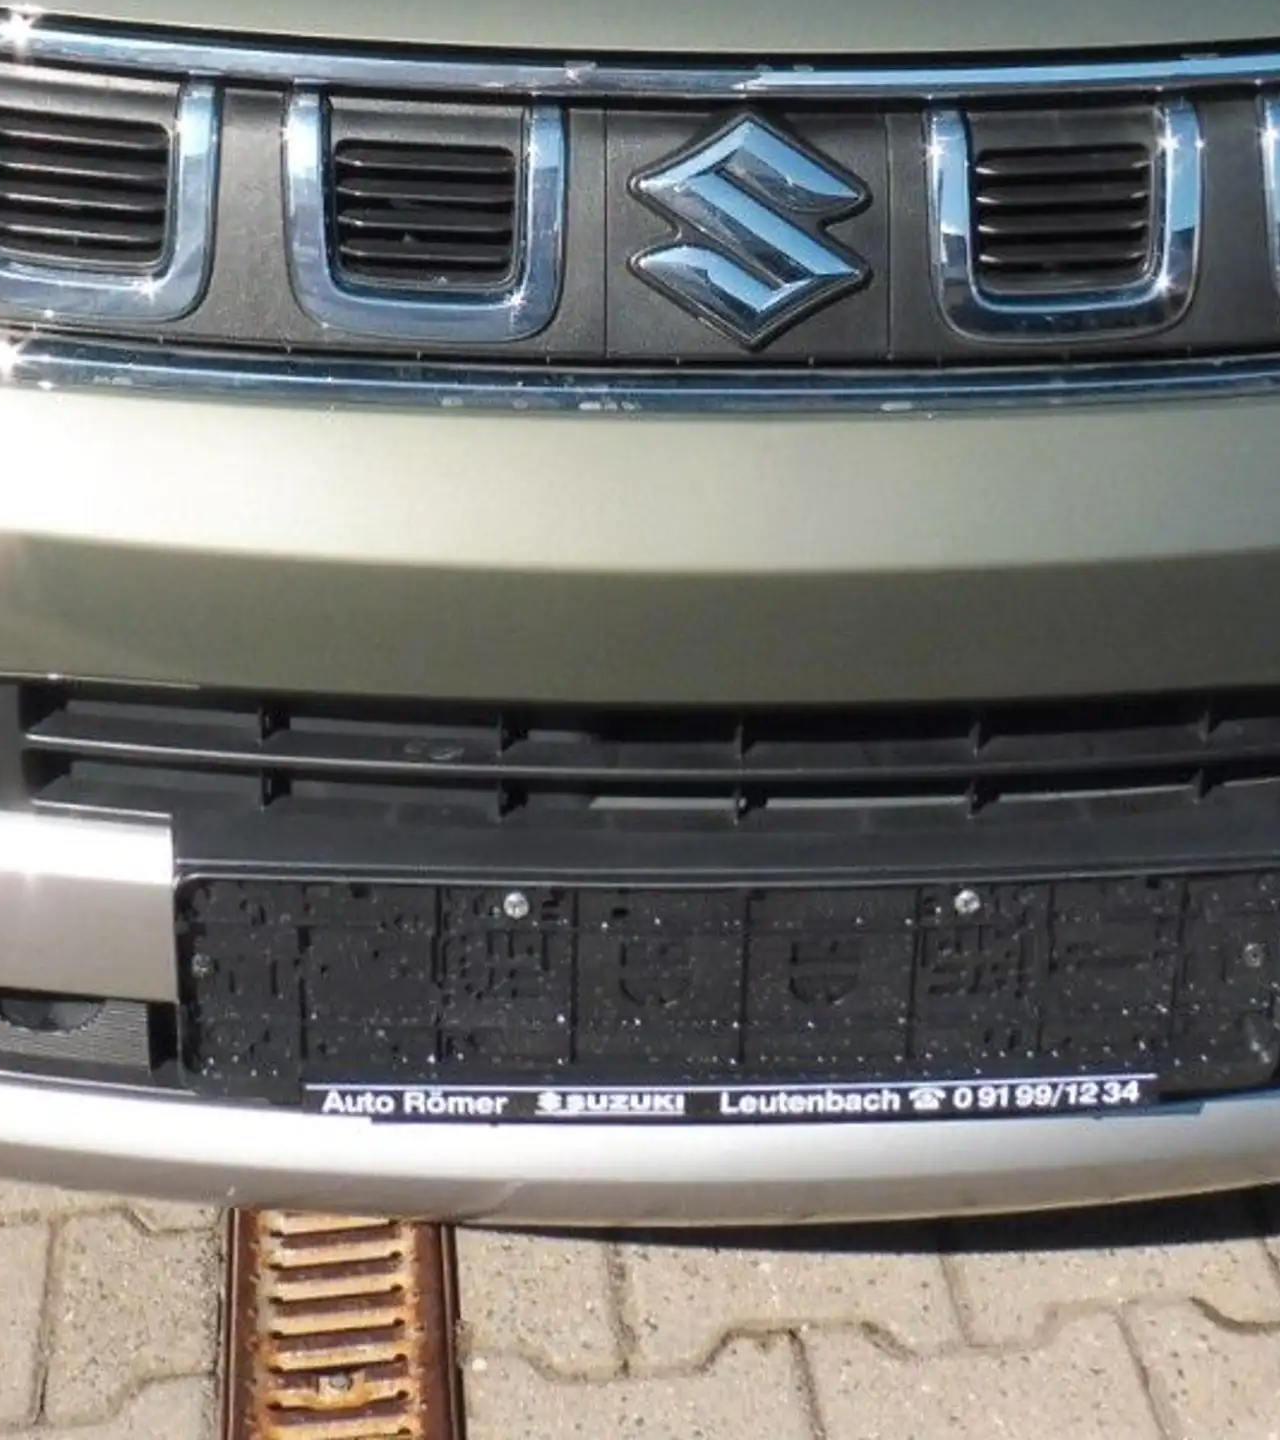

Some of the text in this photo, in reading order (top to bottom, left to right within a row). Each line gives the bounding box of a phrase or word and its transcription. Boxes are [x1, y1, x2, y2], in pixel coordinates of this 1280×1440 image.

[322, 1090, 396, 1115] Auto
[403, 1089, 510, 1117] Römer
[719, 1089, 900, 1115] Leutenbach
